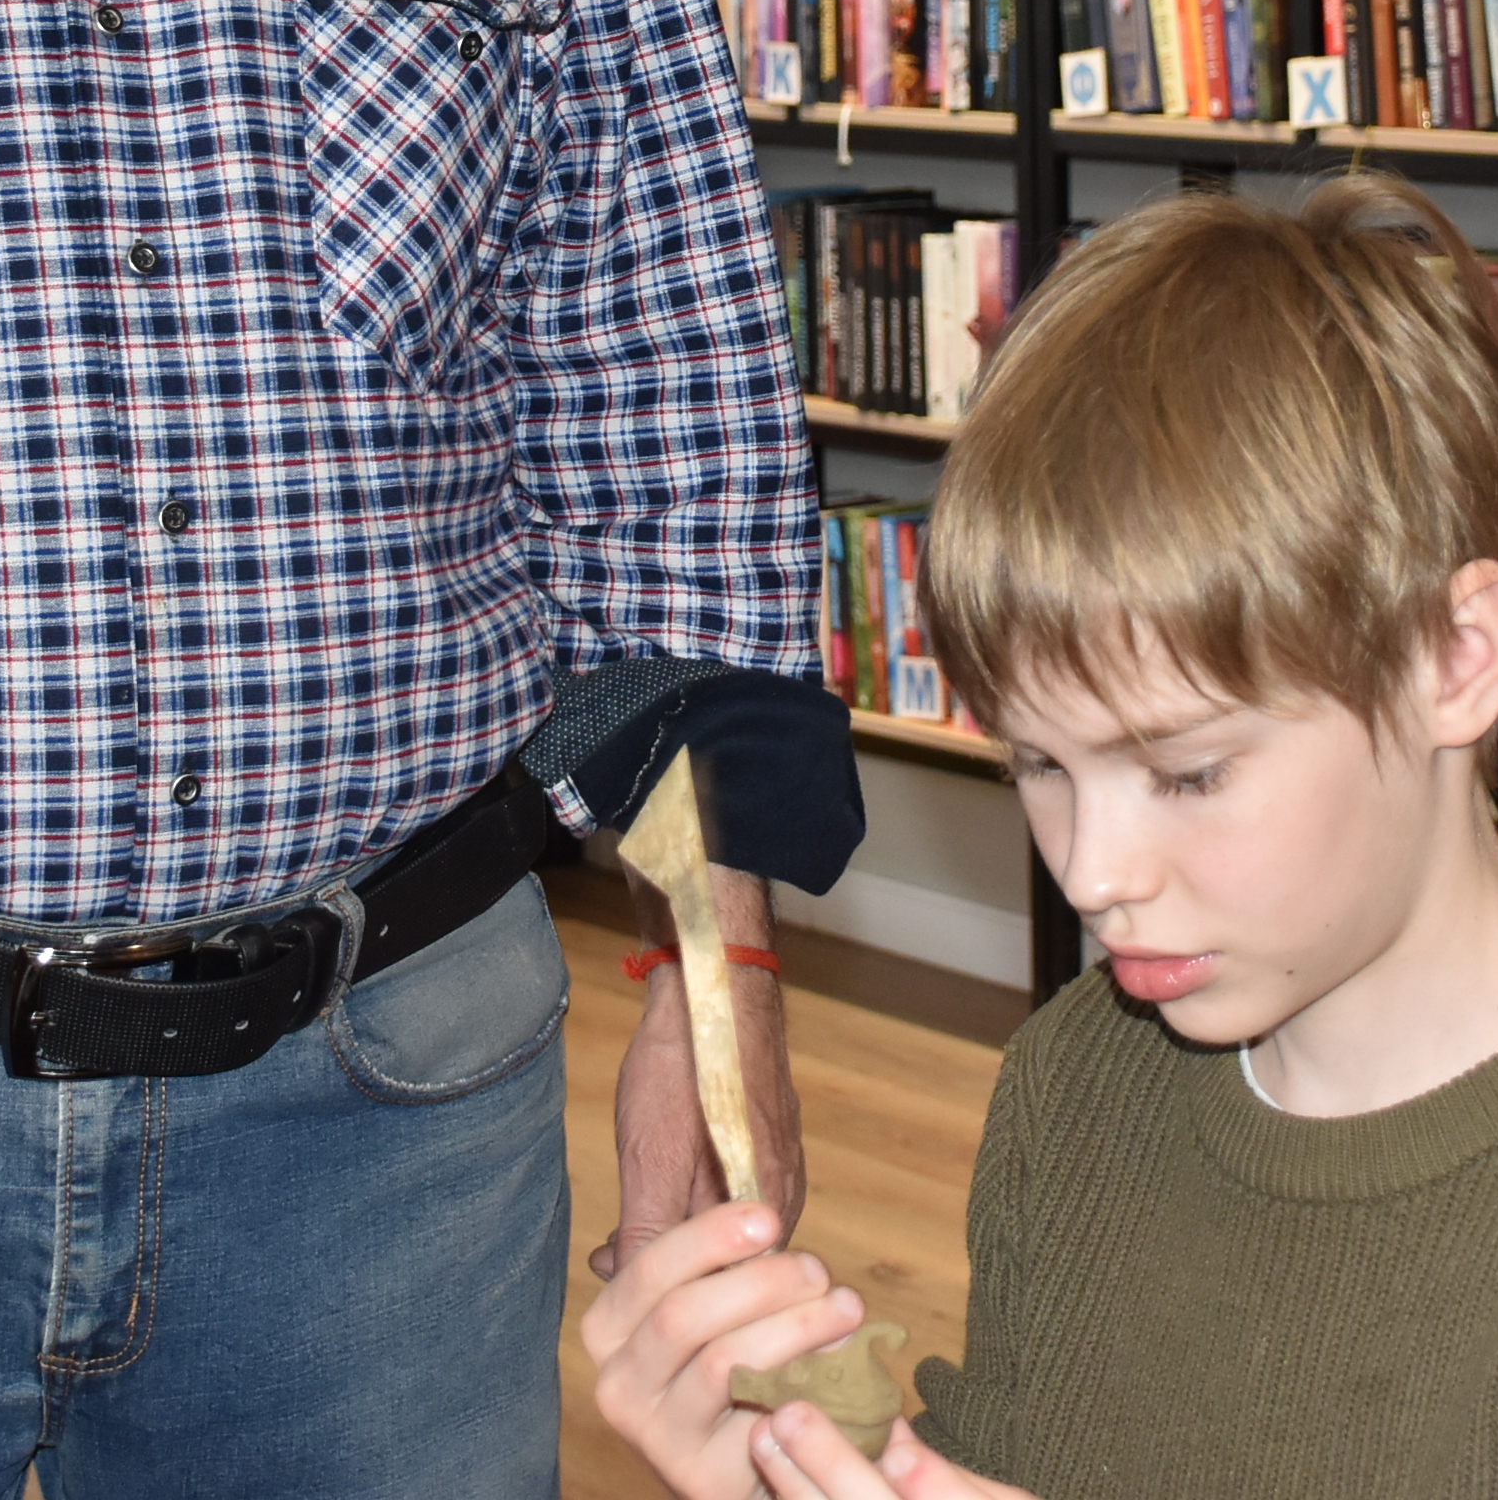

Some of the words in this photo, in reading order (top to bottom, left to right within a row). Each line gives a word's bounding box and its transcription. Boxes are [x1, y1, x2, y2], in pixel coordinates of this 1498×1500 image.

[770, 51, 793, 98] К
[1300, 70, 1337, 122] Х
[903, 666, 938, 712] М
